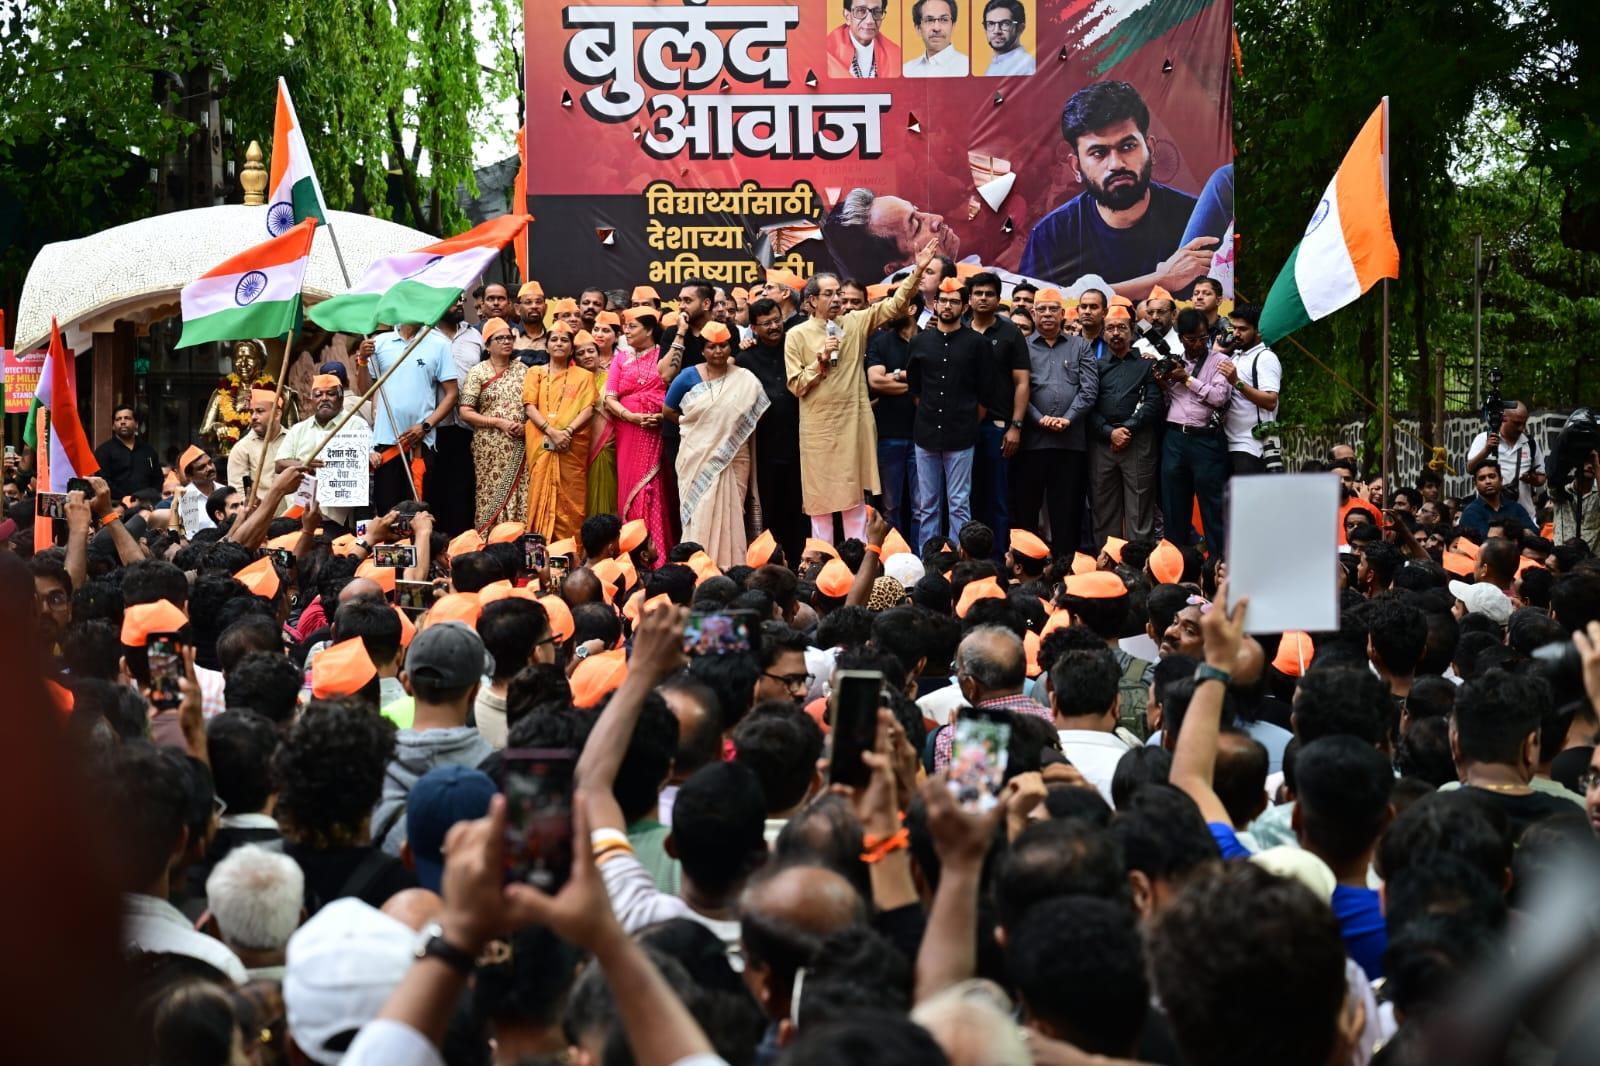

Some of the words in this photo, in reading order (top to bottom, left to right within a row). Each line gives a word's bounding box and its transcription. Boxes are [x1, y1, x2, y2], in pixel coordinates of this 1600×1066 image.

[641, 93, 892, 160] आवाज
[646, 183, 821, 218] विद्यार्थ्यांसाठी,
[646, 219, 744, 250] देशाच्या
